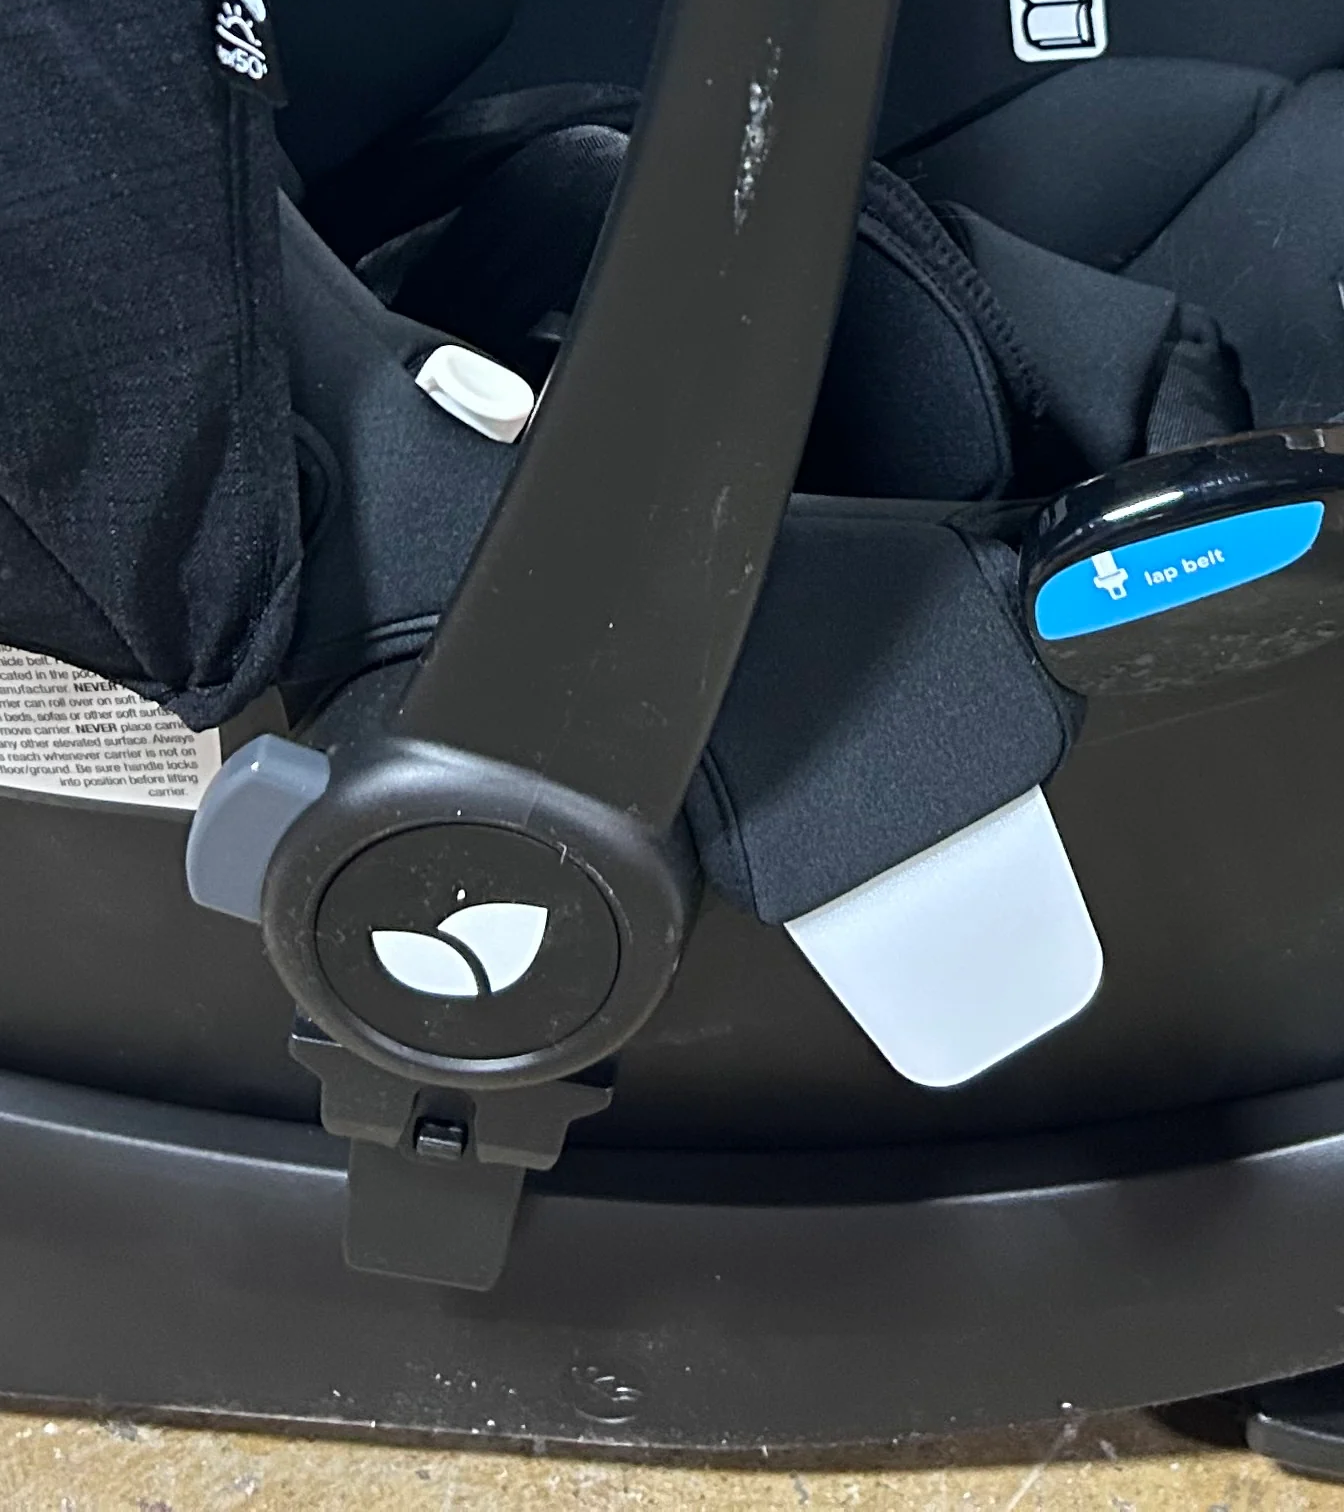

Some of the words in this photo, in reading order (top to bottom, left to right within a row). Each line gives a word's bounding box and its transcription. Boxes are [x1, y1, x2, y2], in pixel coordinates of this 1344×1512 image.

[1143, 566, 1179, 587] lap
[1181, 548, 1225, 574] belt
[35, 669, 47, 680] in
[49, 669, 68, 680] the
[24, 699, 45, 708] can
[48, 697, 66, 707] roll
[69, 697, 93, 707] over
[96, 697, 112, 706] on
[114, 695, 137, 705] soft
[37, 711, 67, 721] sofas
[70, 711, 80, 720] or
[84, 710, 112, 720] other
[116, 708, 138, 719] soft
[0, 726, 32, 735] move
[75, 723, 118, 734] NEVER
[120, 722, 152, 733] place
[20, 738, 49, 748] other
[53, 737, 101, 748] elevated
[152, 734, 195, 745] Always
[8, 752, 41, 761] reach
[42, 750, 100, 761] whenever
[104, 749, 142, 760] carrier
[145, 748, 157, 758] is
[158, 747, 178, 758] not
[181, 747, 196, 757] on
[76, 763, 92, 773] Be
[94, 763, 121, 773] sure
[123, 760, 164, 772] handle
[166, 759, 199, 770] locks
[59, 775, 81, 787] into
[83, 775, 127, 788] position
[129, 774, 165, 785] before
[167, 773, 199, 784] lifting
